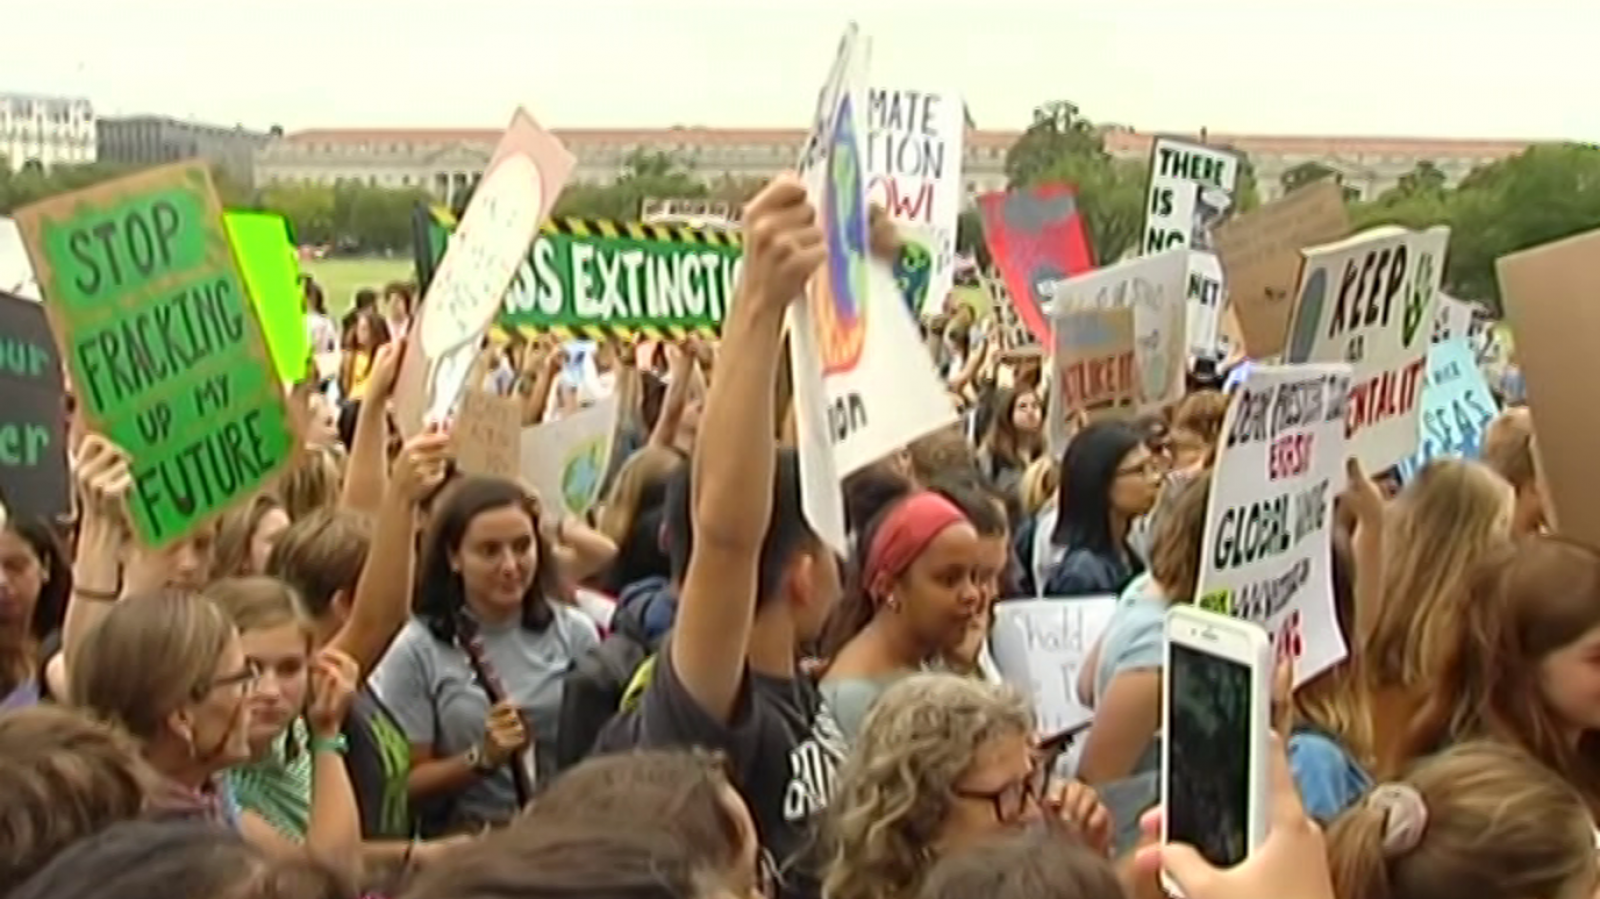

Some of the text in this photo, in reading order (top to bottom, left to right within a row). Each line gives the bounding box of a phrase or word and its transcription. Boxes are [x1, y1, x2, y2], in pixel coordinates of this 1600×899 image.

[867, 86, 941, 136] MATE
[1152, 186, 1174, 217] IS
[1160, 148, 1226, 188] THERE
[69, 201, 180, 296] STOP
[1328, 242, 1407, 340] KEEP
[0, 337, 49, 376] ur
[78, 279, 244, 413] FRACKING
[136, 373, 233, 446] UP MY
[135, 408, 276, 538] FUTURE
[1214, 493, 1291, 570] GLOBAL
